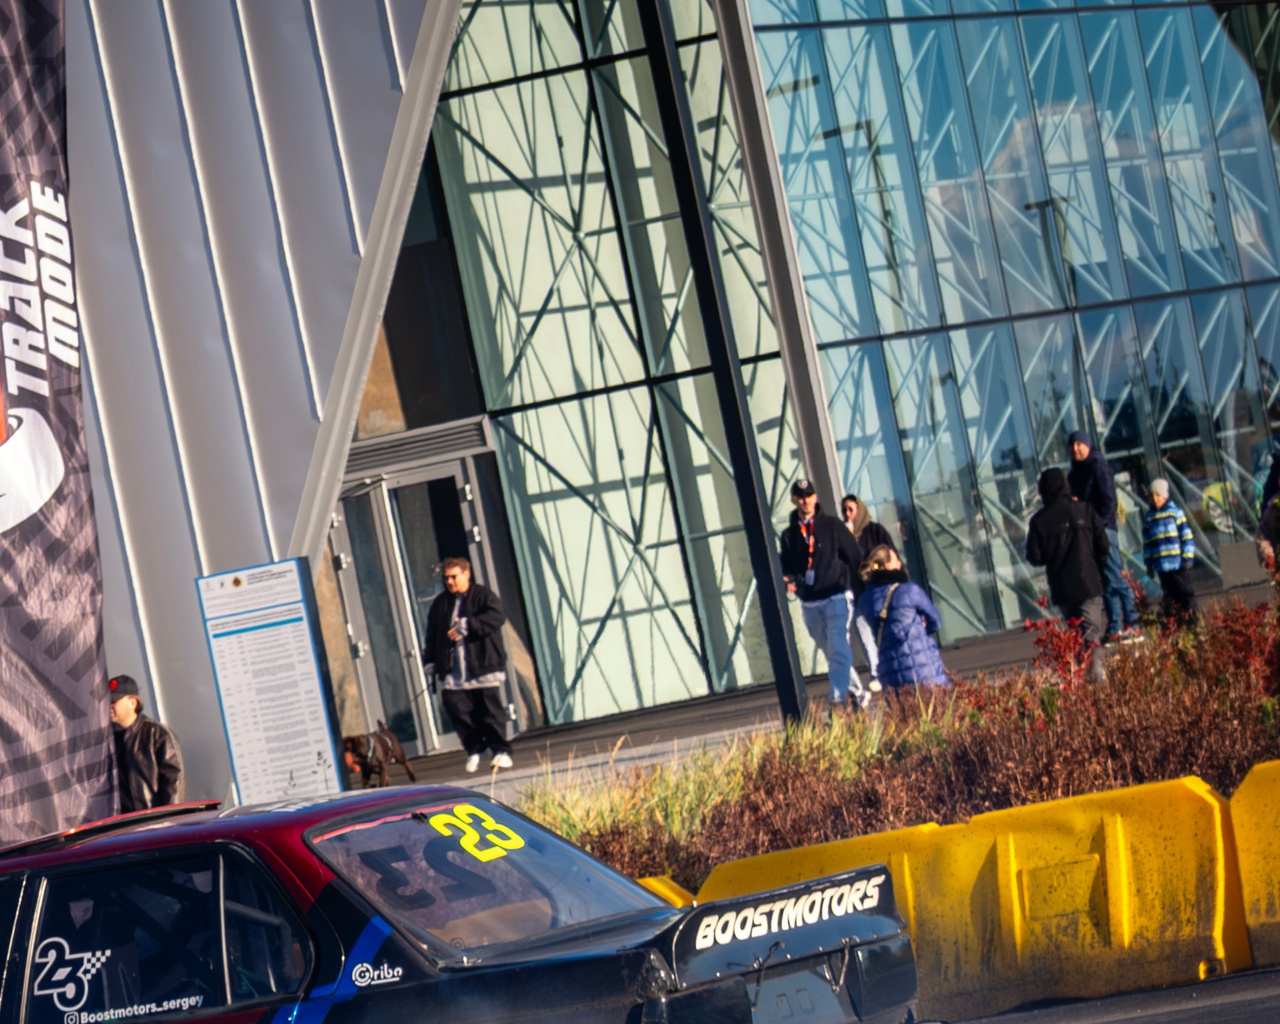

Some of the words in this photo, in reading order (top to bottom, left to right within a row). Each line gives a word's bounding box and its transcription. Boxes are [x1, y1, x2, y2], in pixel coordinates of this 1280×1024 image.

[30, 180, 80, 369] MODE
[428, 803, 525, 863] 23
[695, 874, 886, 950] BOOSTMOTORS
[34, 937, 92, 1012] 23
[80, 995, 204, 1024] Boostmotors_sergey
